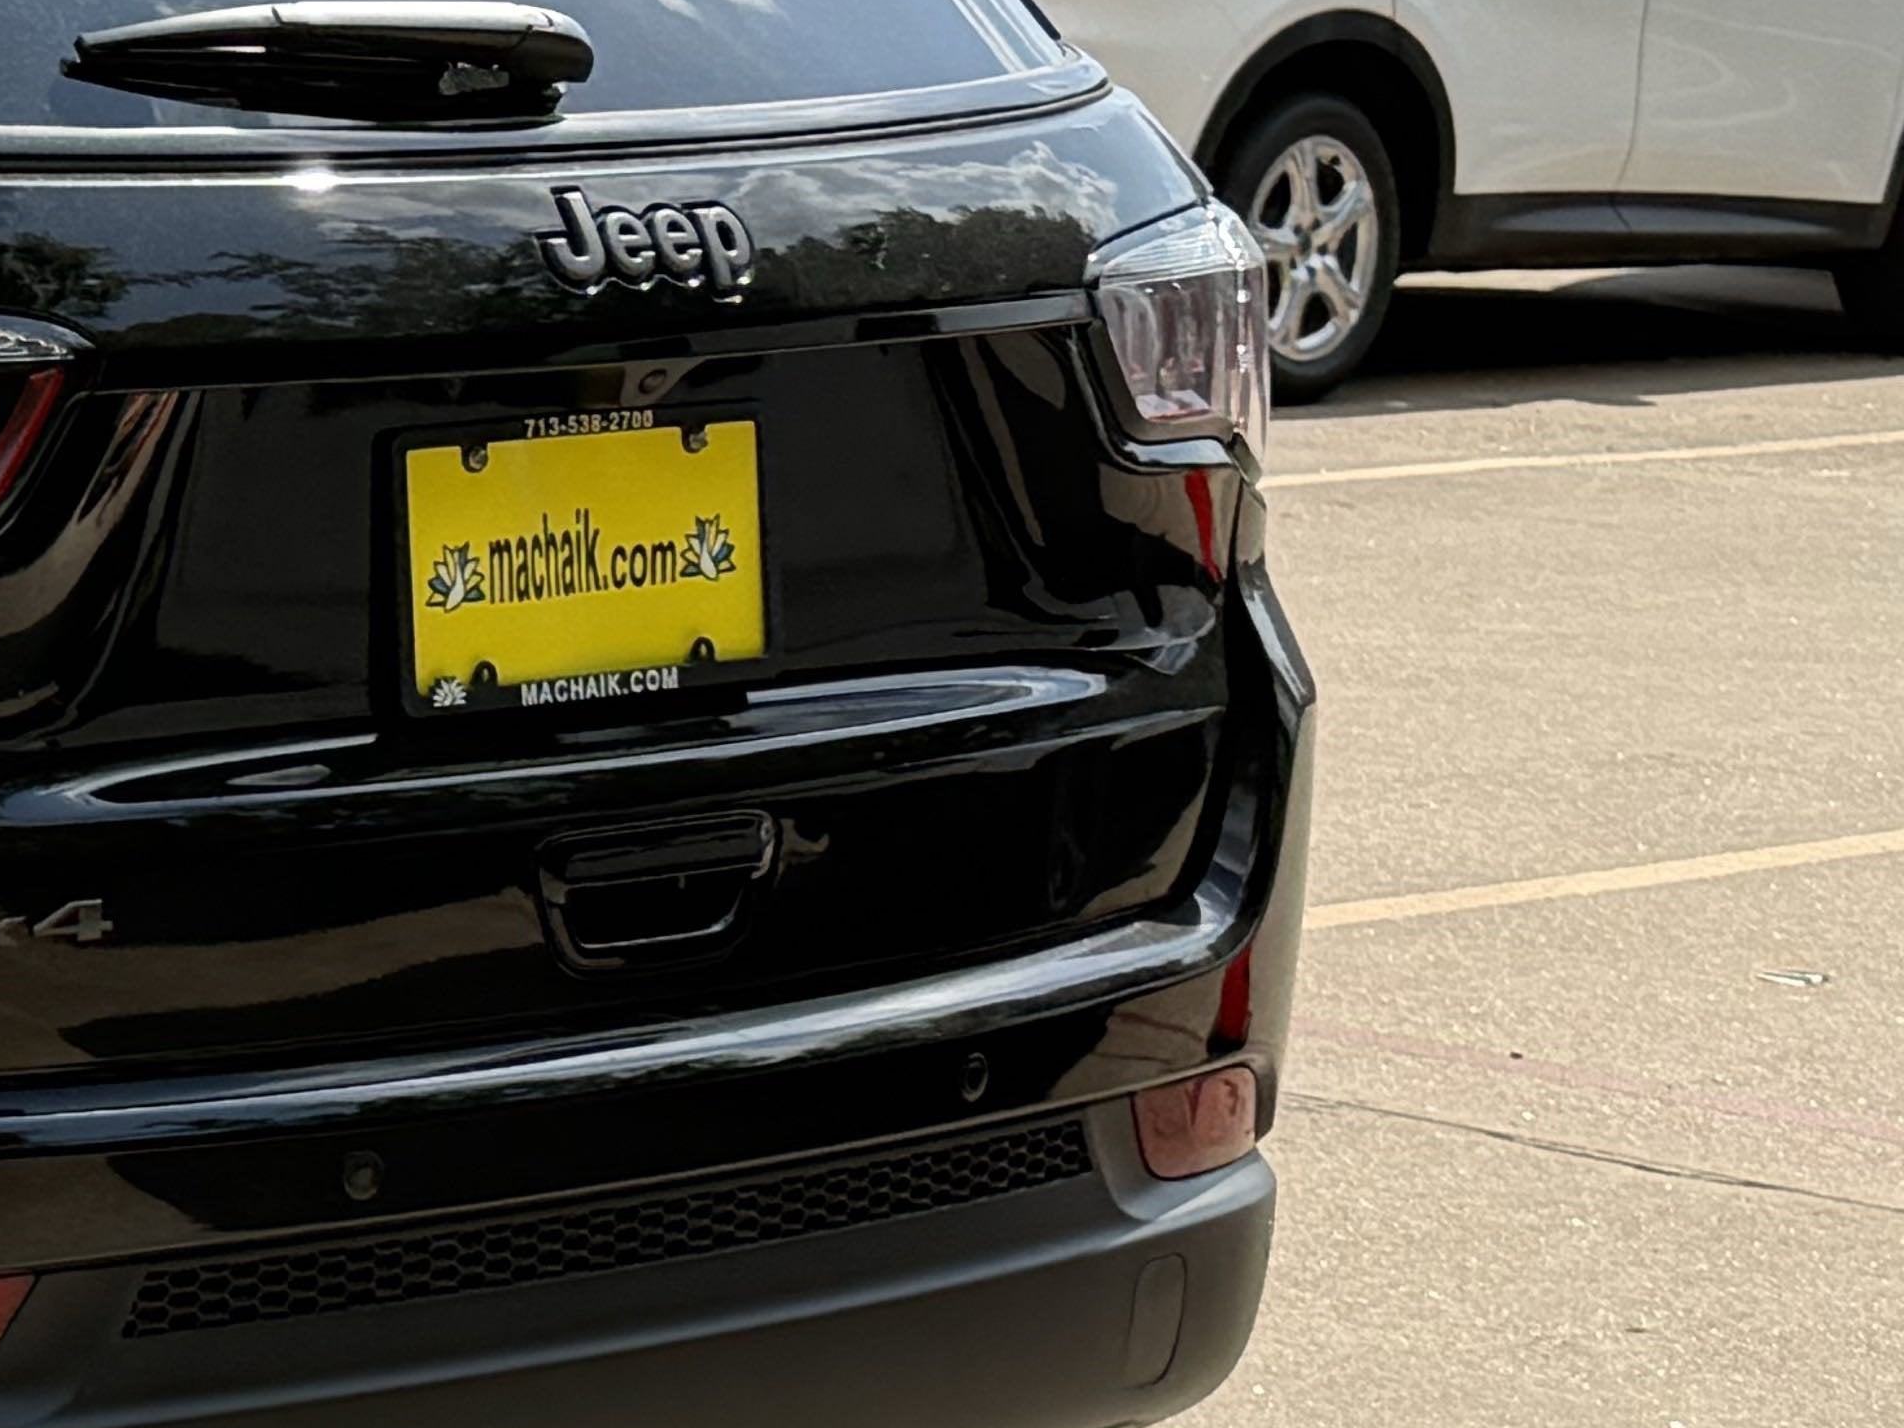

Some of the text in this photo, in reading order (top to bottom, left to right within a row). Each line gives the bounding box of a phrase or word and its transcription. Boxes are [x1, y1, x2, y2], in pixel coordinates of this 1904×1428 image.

[532, 184, 755, 304] Jeep
[523, 409, 654, 439] 713-538-2700
[488, 508, 678, 605] machaik.com
[520, 665, 680, 707] MACHAIK.COM
